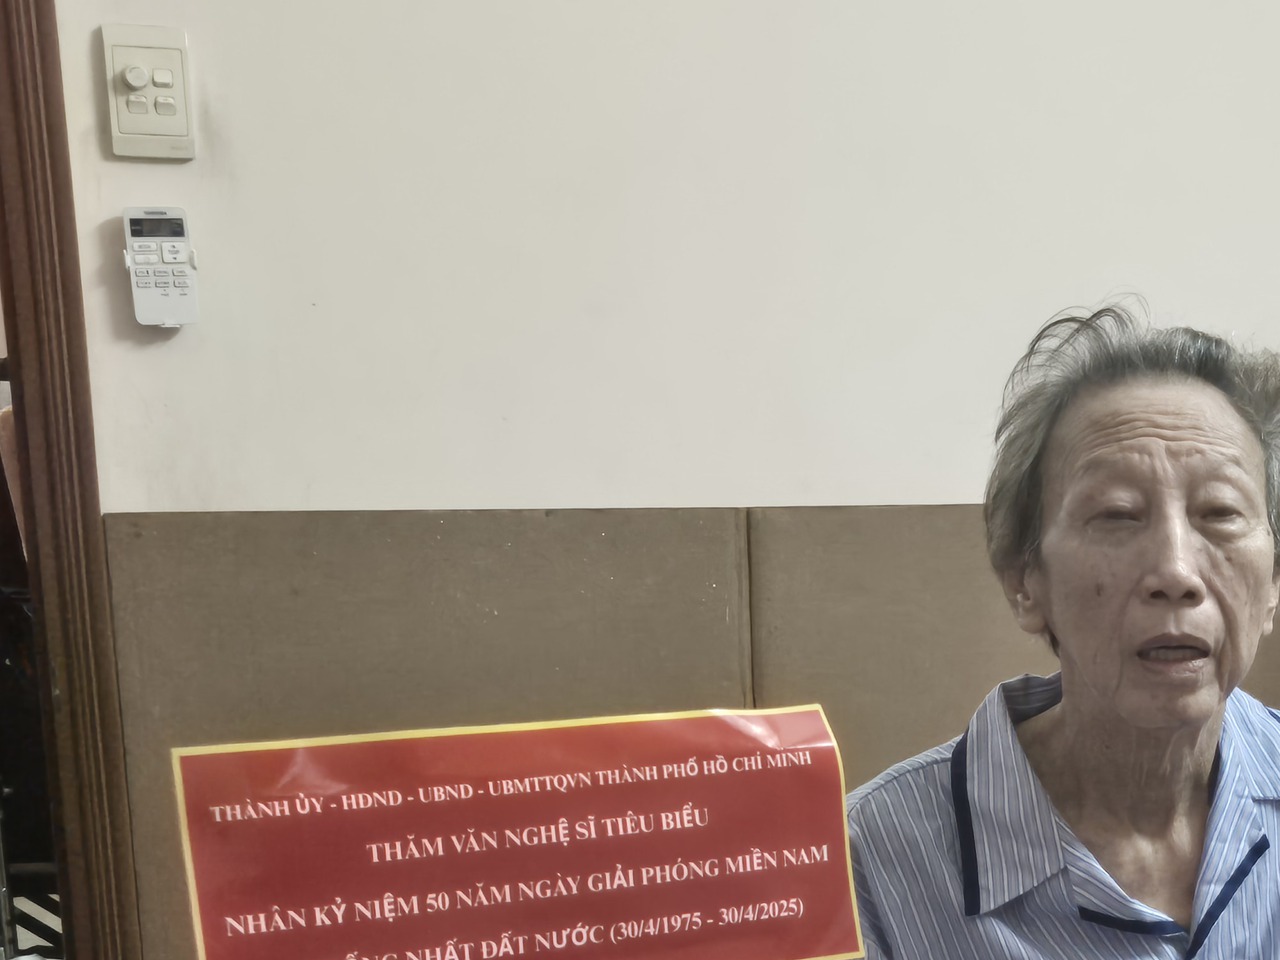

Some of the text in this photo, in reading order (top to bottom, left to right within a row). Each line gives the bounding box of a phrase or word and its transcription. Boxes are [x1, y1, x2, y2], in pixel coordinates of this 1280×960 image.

[210, 799, 290, 822] THÀNH
[297, 793, 325, 815] ỦY
[342, 790, 403, 810] HĐND
[419, 783, 473, 803] UBND
[488, 771, 592, 796] UBMTTQVN
[596, 764, 658, 786] THÀNH
[663, 755, 699, 779] PHỐ
[703, 755, 728, 775] HỒ
[767, 751, 812, 768] MINH
[366, 802, 709, 863] THĂM VĂN NGHỆ SĨ TIÊU BIỂU
[224, 845, 829, 937] NHÂN KỶ NIỆM 50 NĂM NGÀY GIẢI PHÓNG MIỀN NAM
[481, 931, 528, 959] ĐẤT
[535, 925, 604, 953] NƯỚC
[610, 912, 702, 945] (30/4/1975
[719, 897, 804, 925] 30/4/2025)
